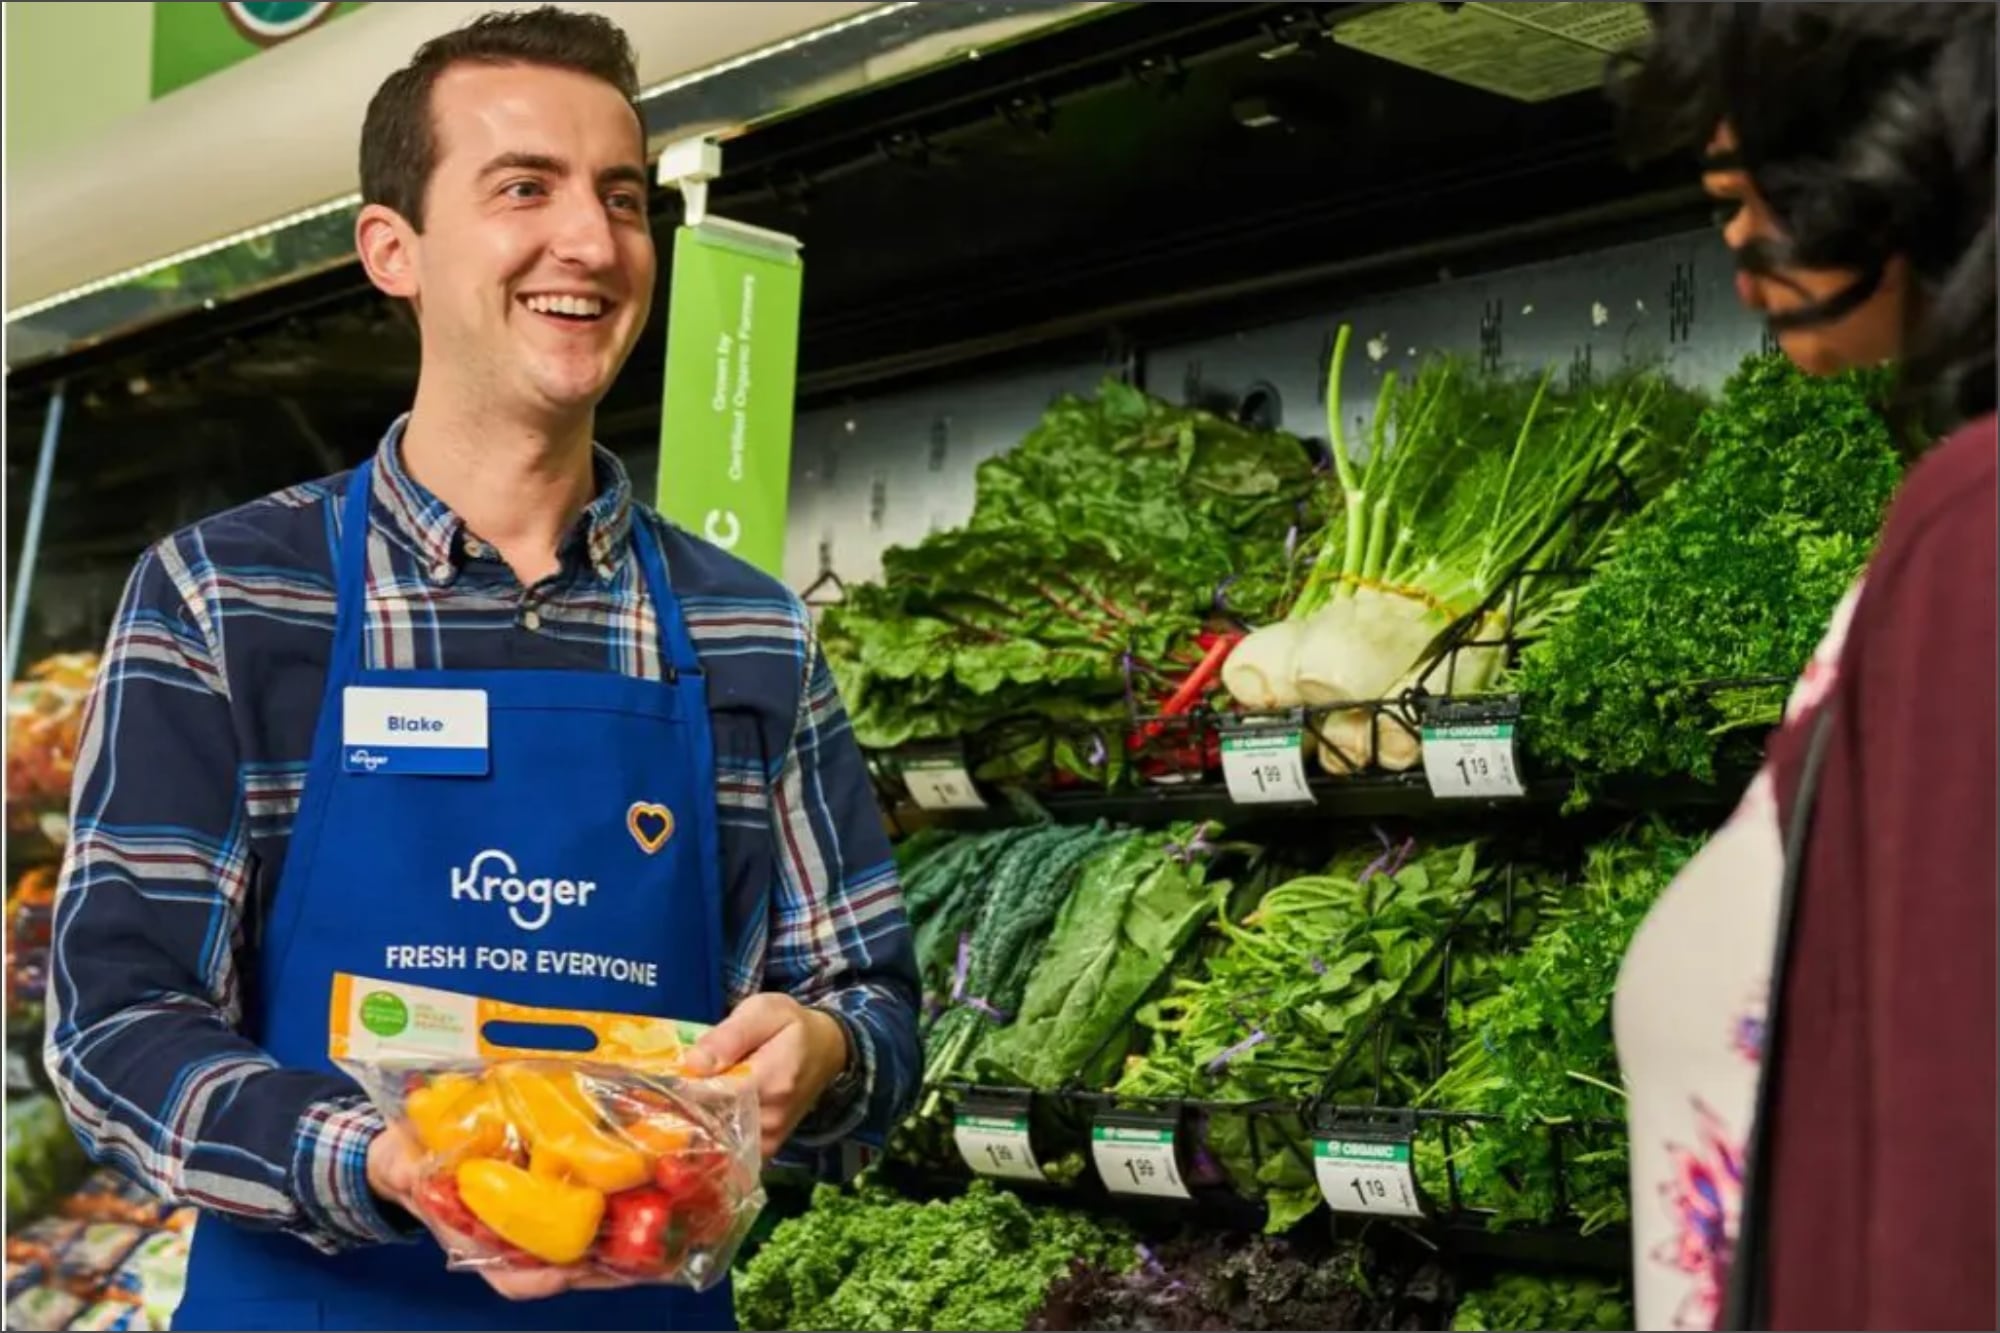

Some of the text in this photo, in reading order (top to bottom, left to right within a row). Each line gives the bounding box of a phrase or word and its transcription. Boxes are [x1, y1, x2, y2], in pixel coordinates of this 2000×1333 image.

[712, 331, 734, 411] Grown by
[729, 274, 755, 481] Certified Organic Farmers
[387, 716, 444, 732] Blake
[350, 750, 389, 771] Kroger
[450, 849, 596, 931] Kroger
[386, 946, 658, 987] FRESH FOR EVERYONE
[1342, 1142, 1395, 1159] ORGANIC
